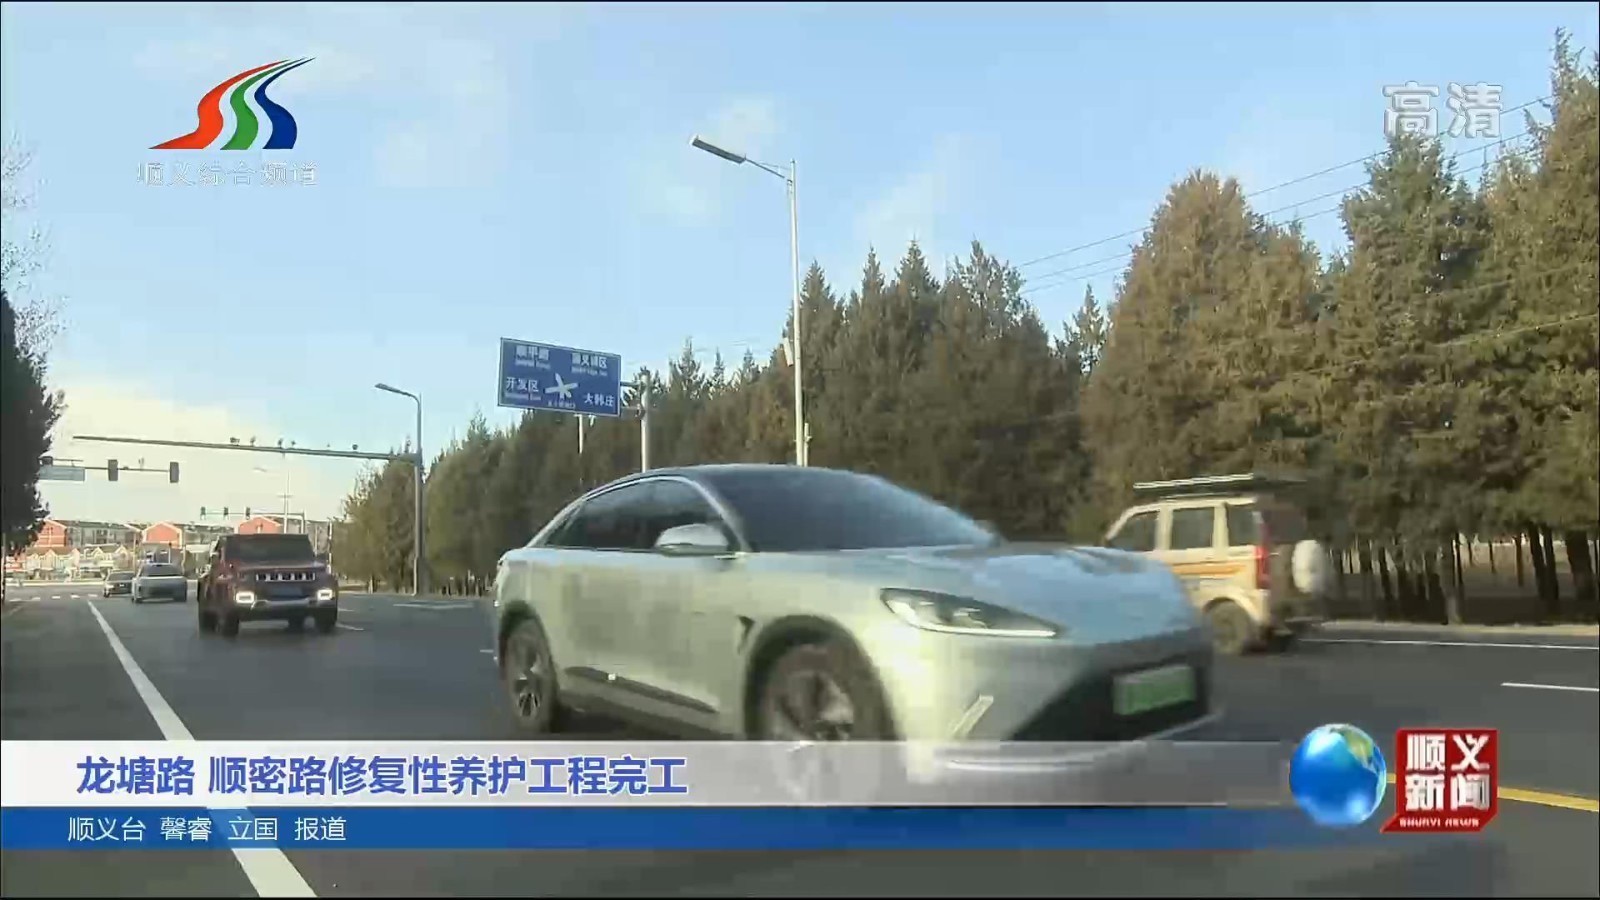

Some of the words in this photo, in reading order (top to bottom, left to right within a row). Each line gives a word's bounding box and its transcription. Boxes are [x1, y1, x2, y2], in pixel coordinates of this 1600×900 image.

[506, 377, 539, 393] 开发区
[584, 393, 615, 407] 大韩庄
